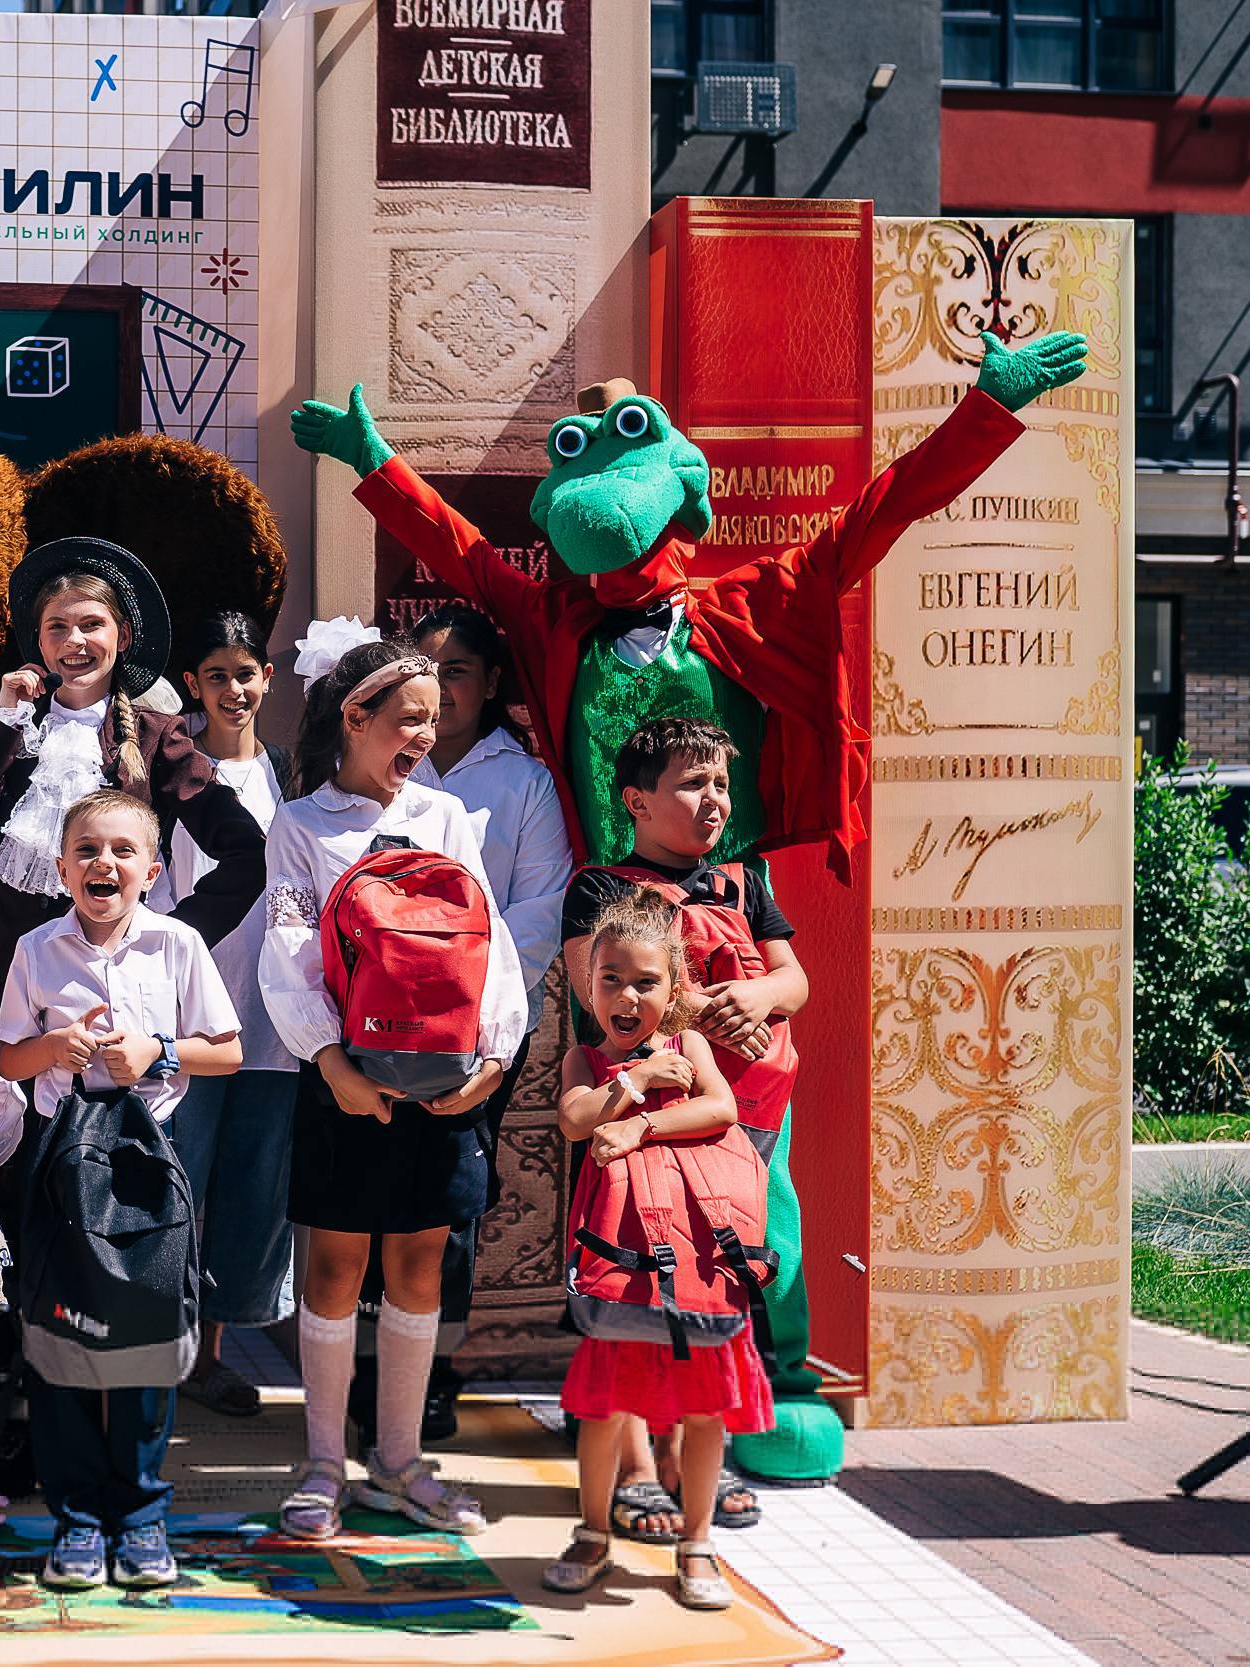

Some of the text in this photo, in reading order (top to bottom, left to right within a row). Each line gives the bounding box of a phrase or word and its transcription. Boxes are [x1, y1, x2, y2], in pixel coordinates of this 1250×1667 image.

[393, 0, 565, 35] ВСЕМИРНАЯ
[418, 50, 544, 88] ДЕТСКАЯ
[390, 107, 572, 148] БИБЛИОТЕКА
[97, 228, 204, 245] ХОЛДИНГ
[710, 463, 835, 501] ВЛАДИМИР
[969, 495, 1080, 525] ПУШКИН
[918, 564, 1080, 611] ЕВГЕНИЙ
[921, 628, 1076, 669] ОНЕГИН
